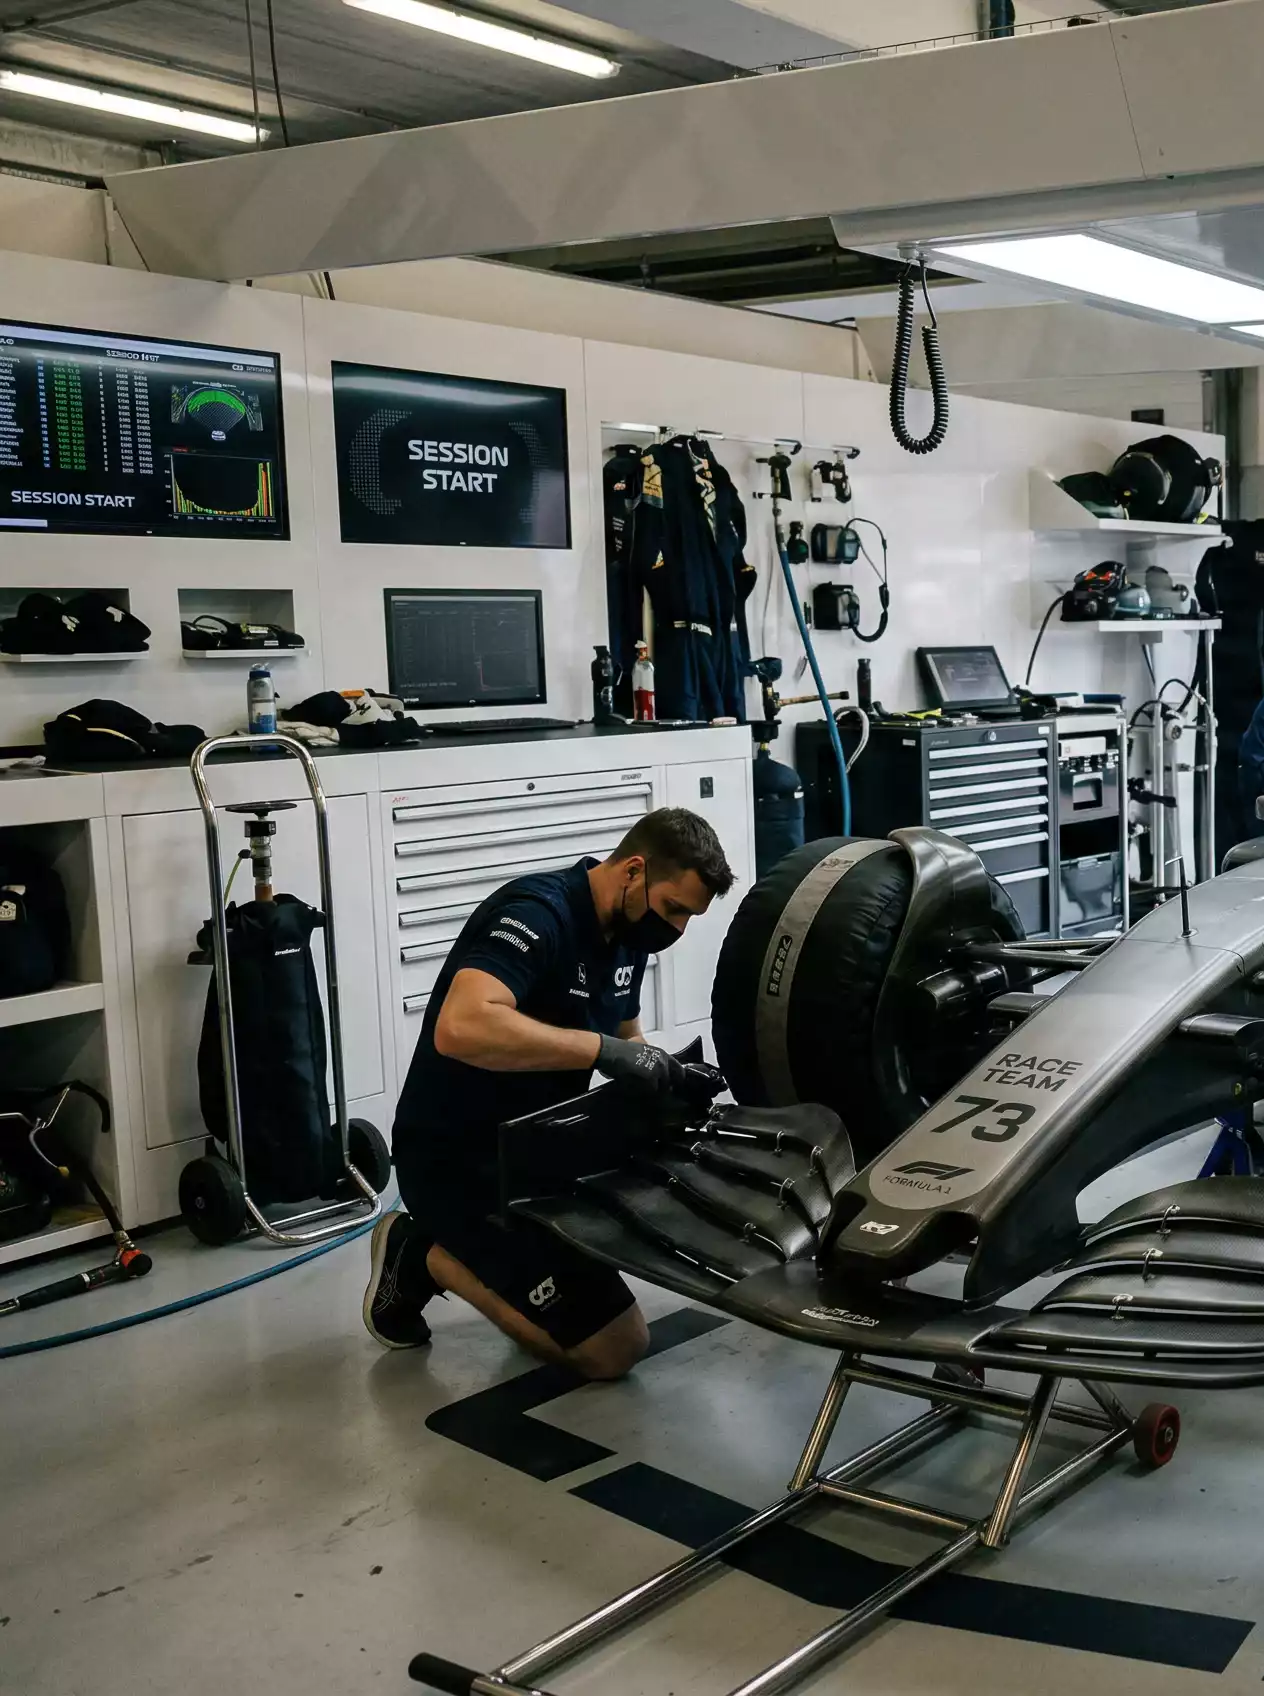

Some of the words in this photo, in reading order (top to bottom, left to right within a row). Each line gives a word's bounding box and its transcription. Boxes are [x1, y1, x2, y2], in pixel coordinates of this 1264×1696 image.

[408, 439, 509, 467] SESSION
[422, 469, 498, 493] START
[11, 490, 82, 506] SESSION
[84, 493, 136, 508] START
[995, 1053, 1083, 1076] RACE
[982, 1068, 1067, 1092] TEAM
[931, 1095, 1036, 1143] 73
[891, 1160, 975, 1181] F1
[882, 1174, 942, 1193] FORMULA
